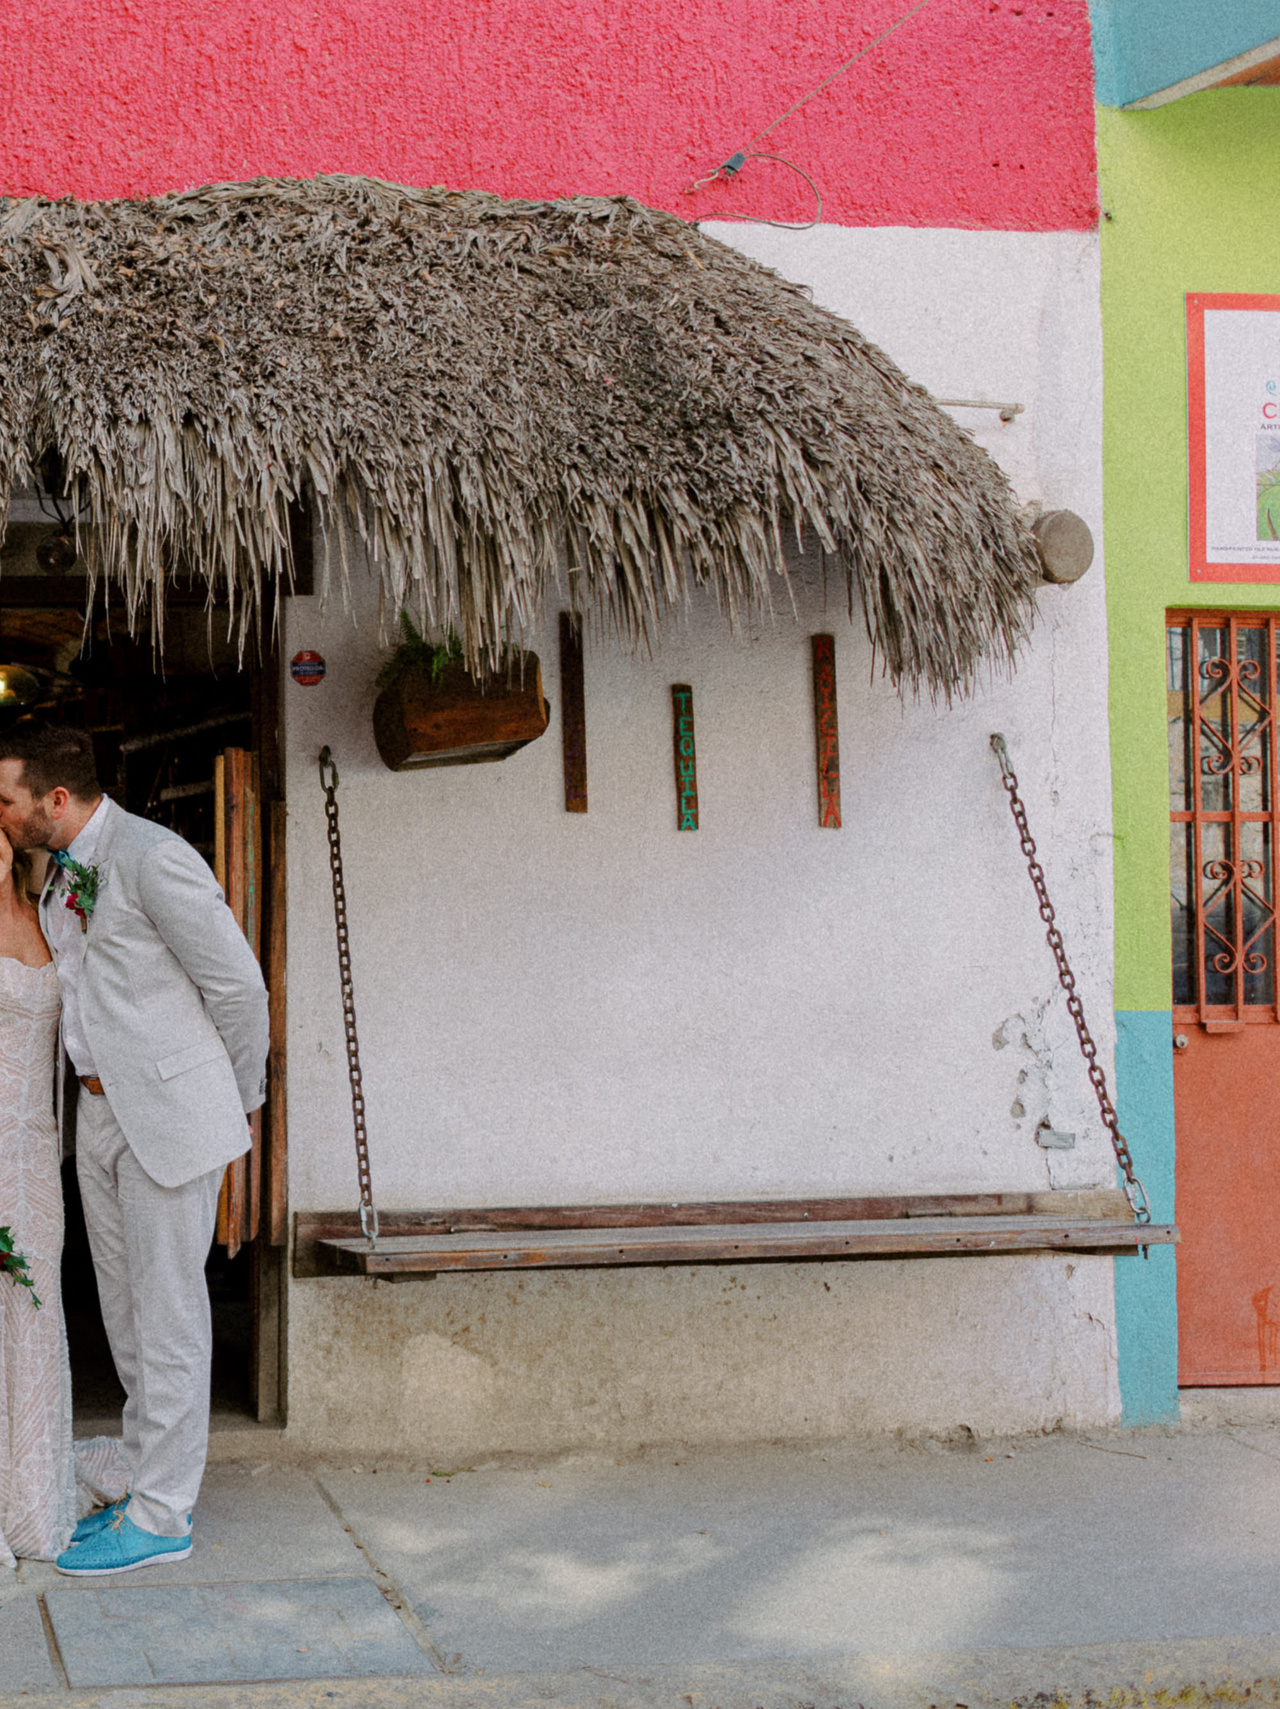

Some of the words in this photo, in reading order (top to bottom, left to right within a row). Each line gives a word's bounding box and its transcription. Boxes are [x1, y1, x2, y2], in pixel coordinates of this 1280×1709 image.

[1262, 402, 1280, 419] C
[675, 693, 697, 831] TEQUILA
[816, 637, 842, 828] RAICILLA
